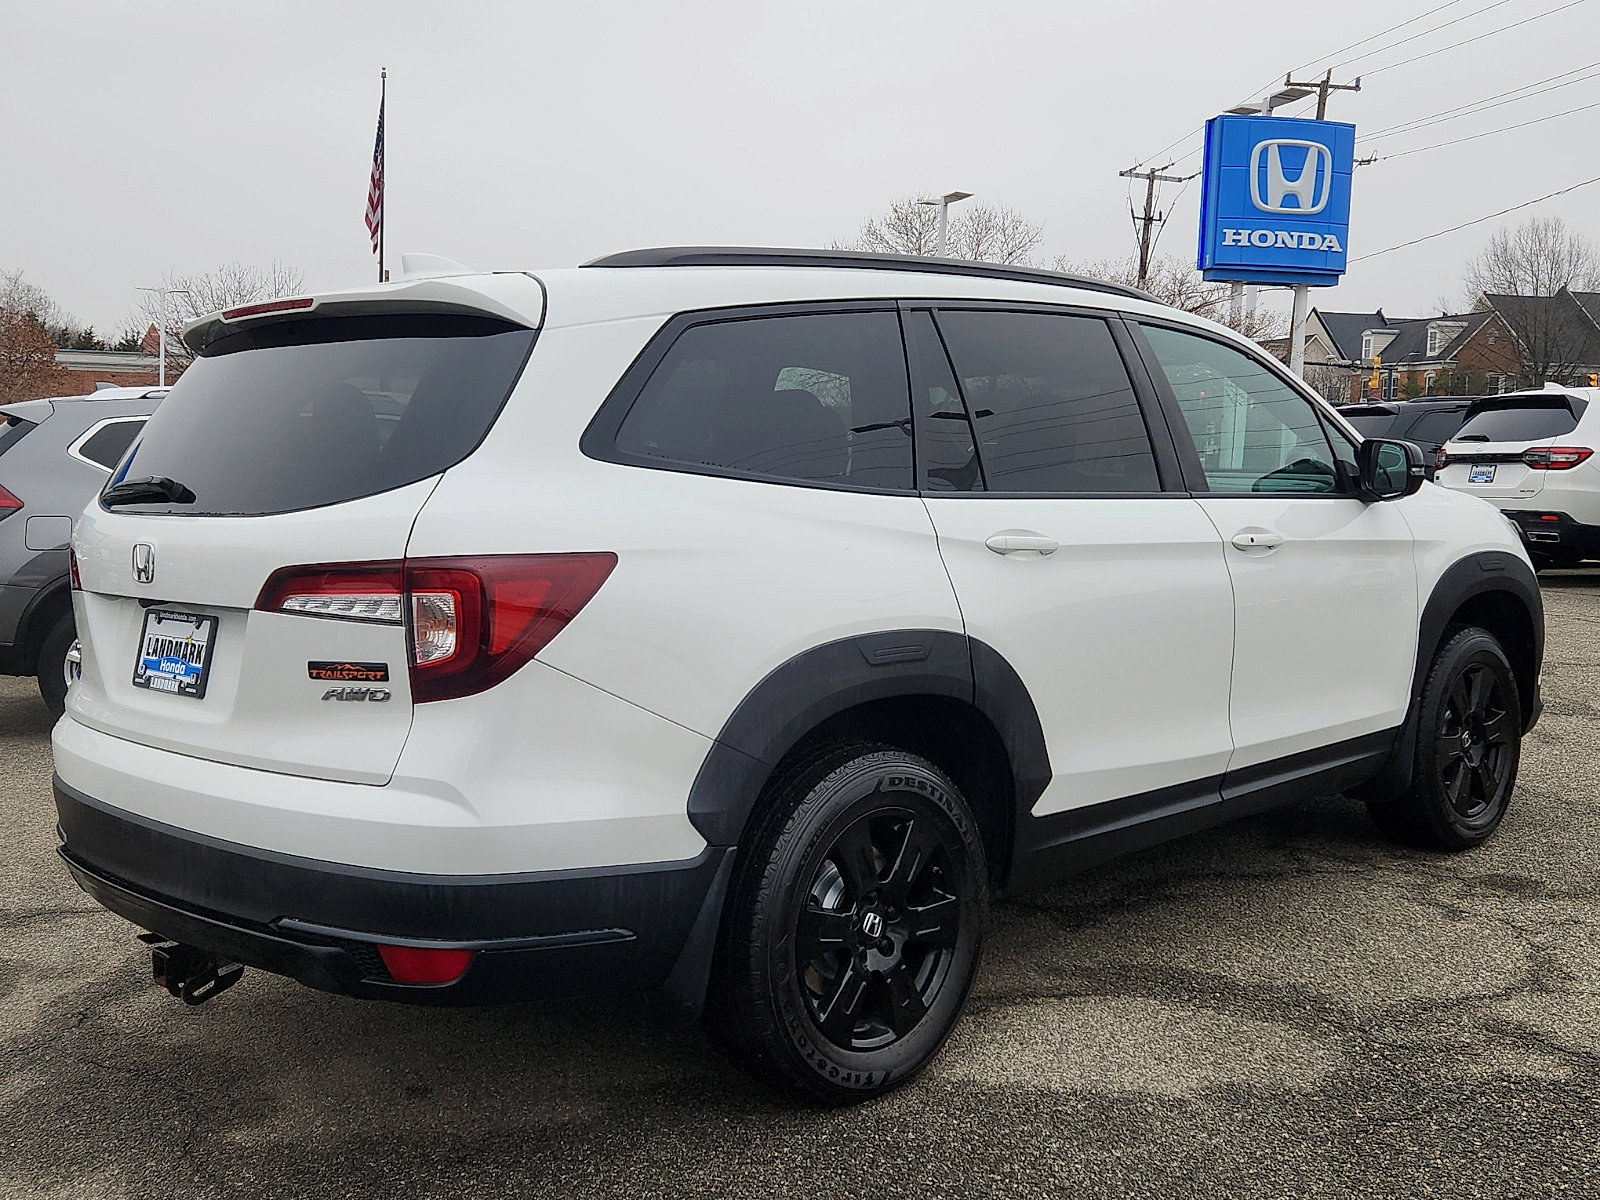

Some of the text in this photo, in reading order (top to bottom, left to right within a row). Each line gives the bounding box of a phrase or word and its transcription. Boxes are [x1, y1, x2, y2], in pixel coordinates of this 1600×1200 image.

[1222, 229, 1343, 251] HONDA
[146, 637, 204, 665] LANDMARK
[160, 659, 186, 675] Honda
[310, 669, 385, 681] TRAILSPORT
[149, 677, 180, 694] LANDMARK
[321, 687, 392, 702] AWD
